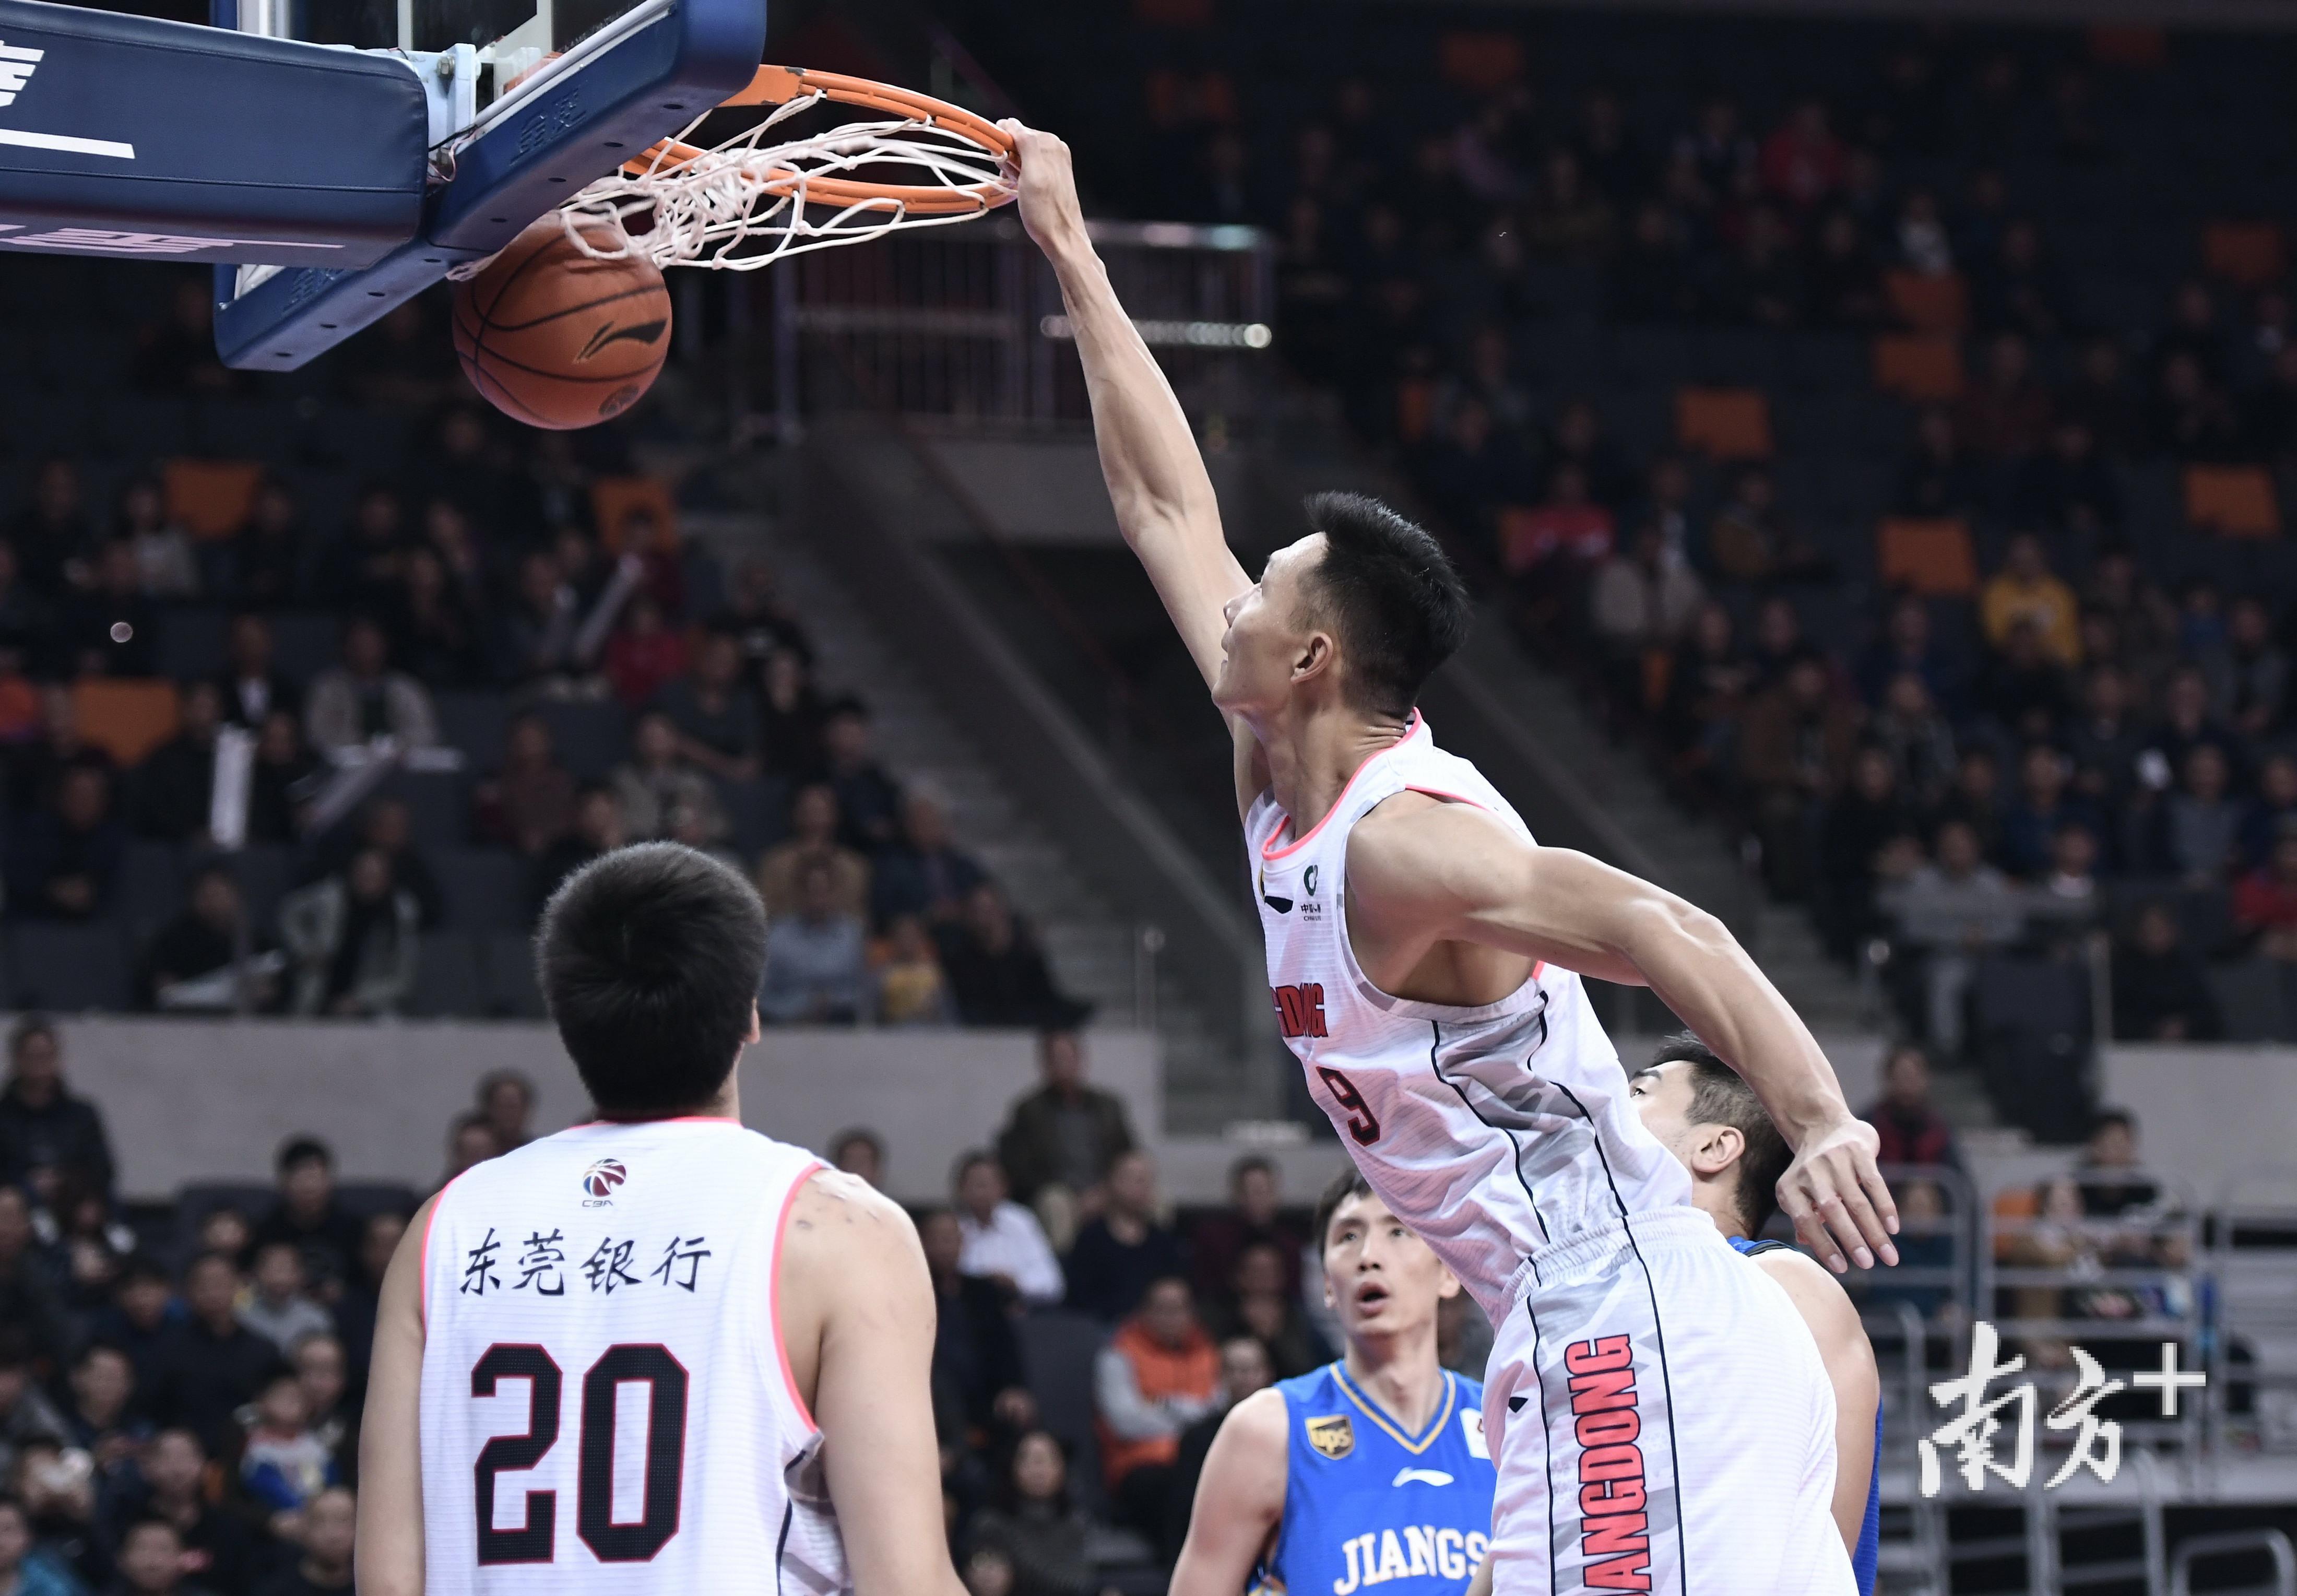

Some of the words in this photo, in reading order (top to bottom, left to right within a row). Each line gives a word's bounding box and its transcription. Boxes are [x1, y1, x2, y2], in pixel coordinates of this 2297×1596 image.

[1316, 1066, 1380, 1147] 9
[582, 1199, 613, 1208] CBA
[459, 1227, 711, 1296] 东莞银行
[471, 1342, 689, 1566] 20
[1564, 1333, 1652, 1596] ANGDONG
[1333, 1524, 1489, 1596] JIANGS
